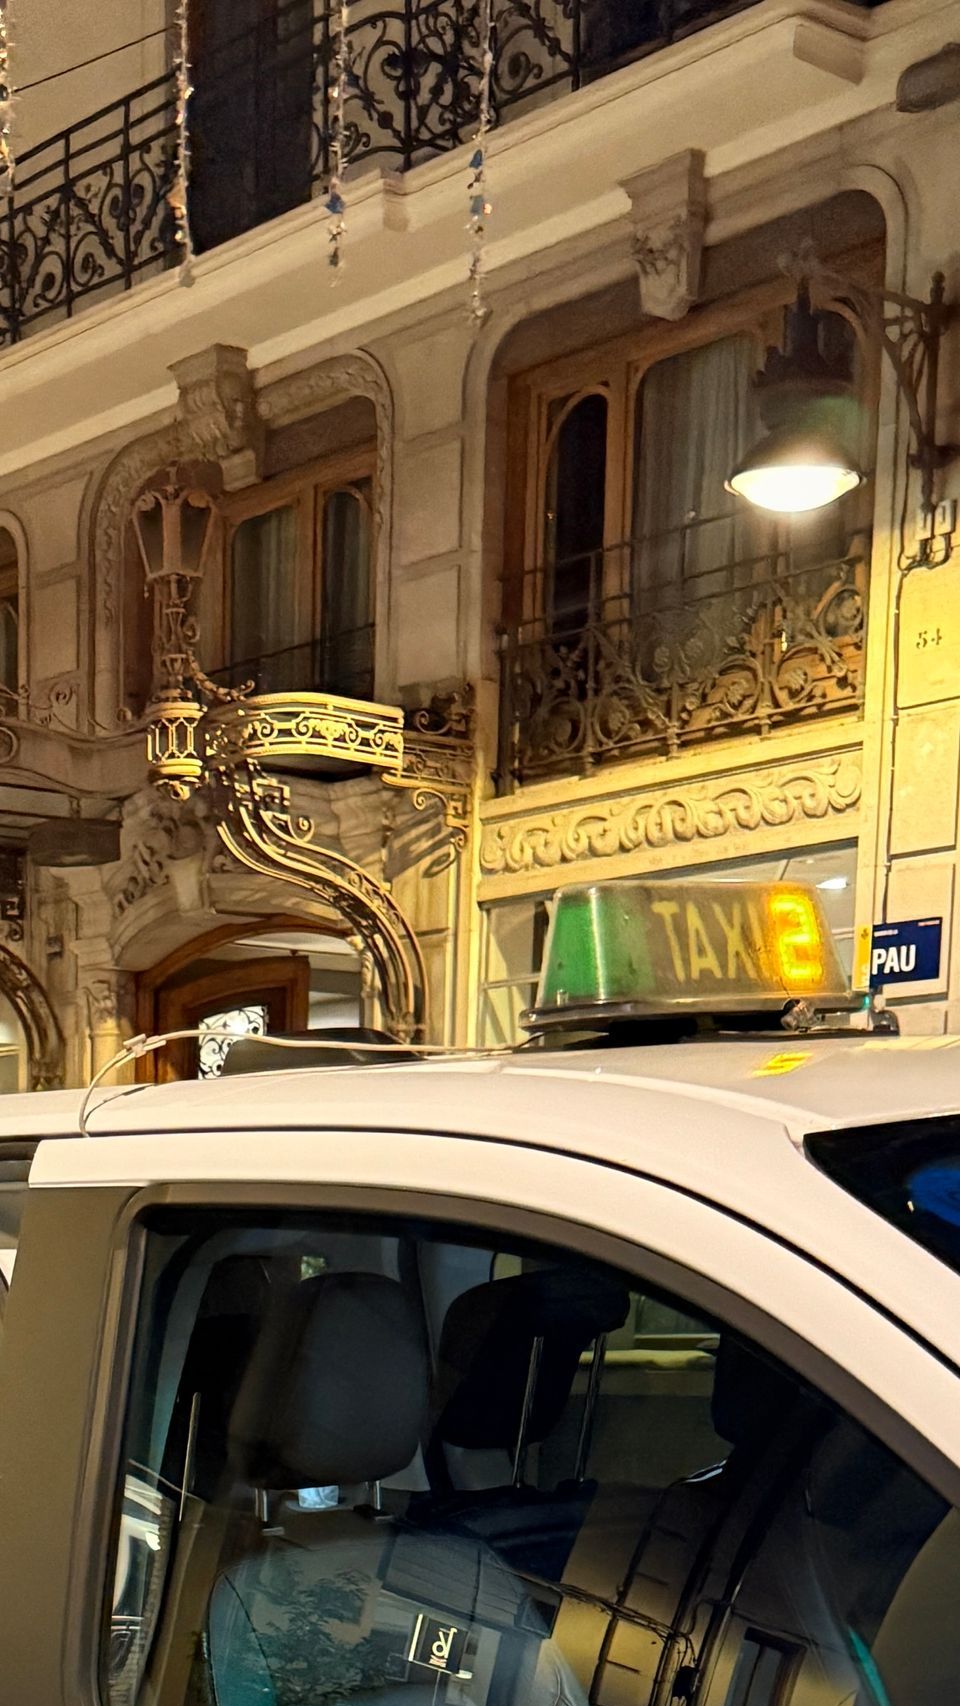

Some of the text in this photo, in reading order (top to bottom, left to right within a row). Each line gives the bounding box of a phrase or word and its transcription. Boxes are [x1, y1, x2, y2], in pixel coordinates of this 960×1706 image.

[651, 900, 778, 984] TAXI
[769, 894, 825, 982] 2
[871, 944, 917, 975] PAU
